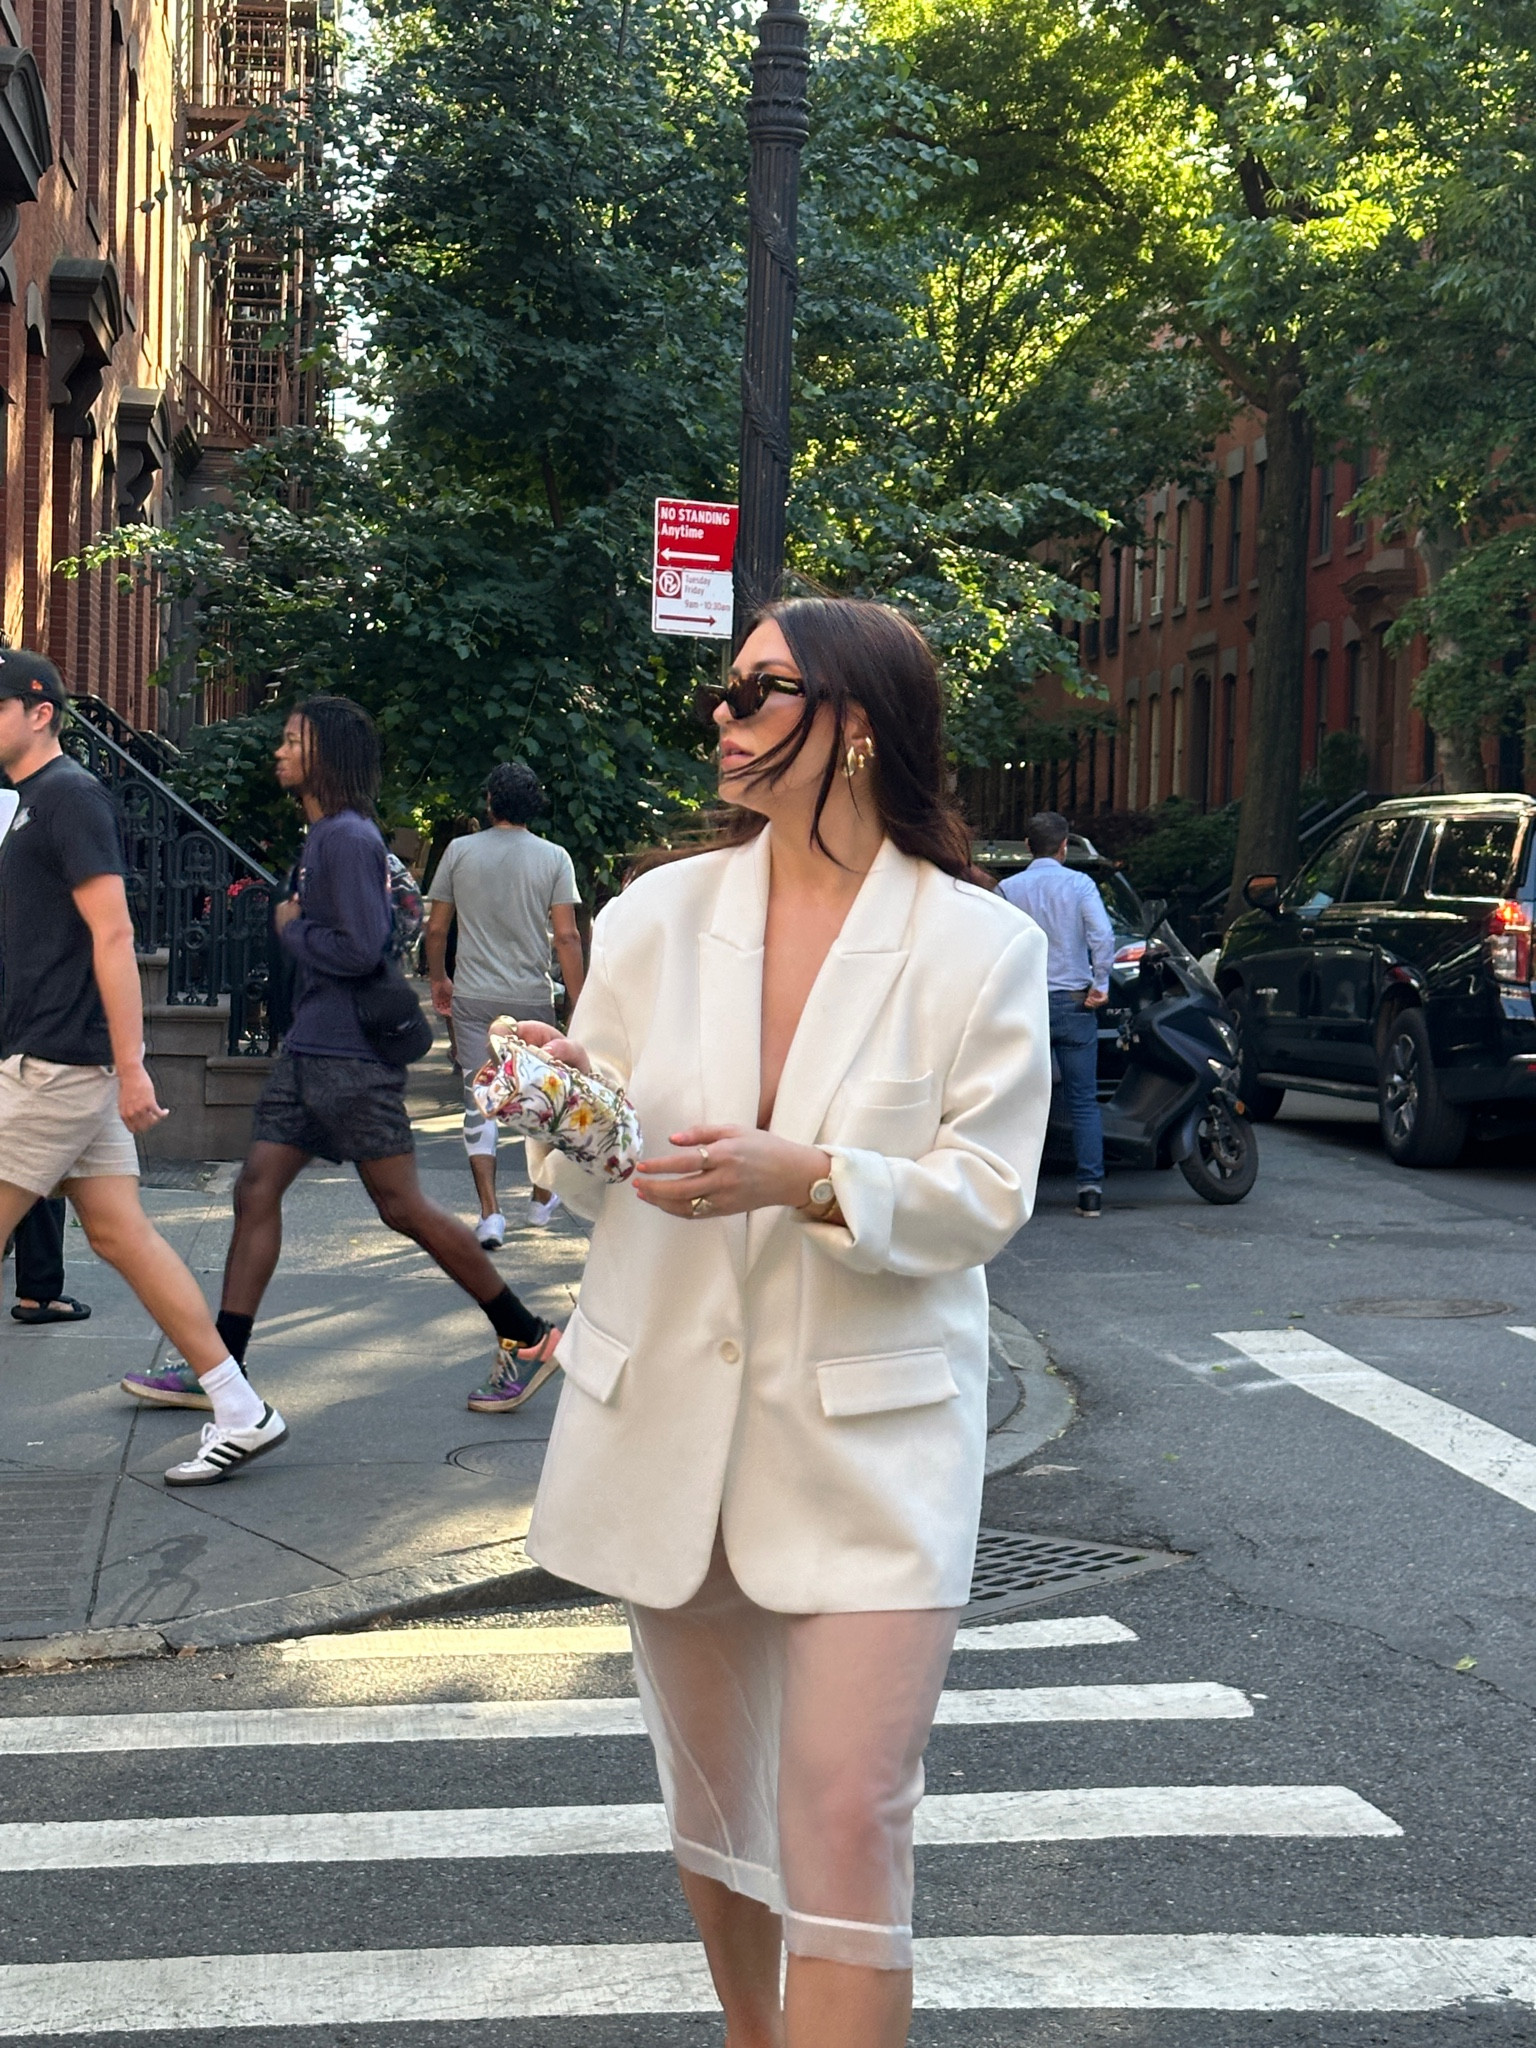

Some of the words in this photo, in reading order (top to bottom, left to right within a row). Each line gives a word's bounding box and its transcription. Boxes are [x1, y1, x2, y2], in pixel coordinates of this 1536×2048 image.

[660, 506, 676, 520] NO
[678, 508, 730, 526] STANDING
[660, 523, 704, 539] Anytime
[684, 585, 705, 596] Friday
